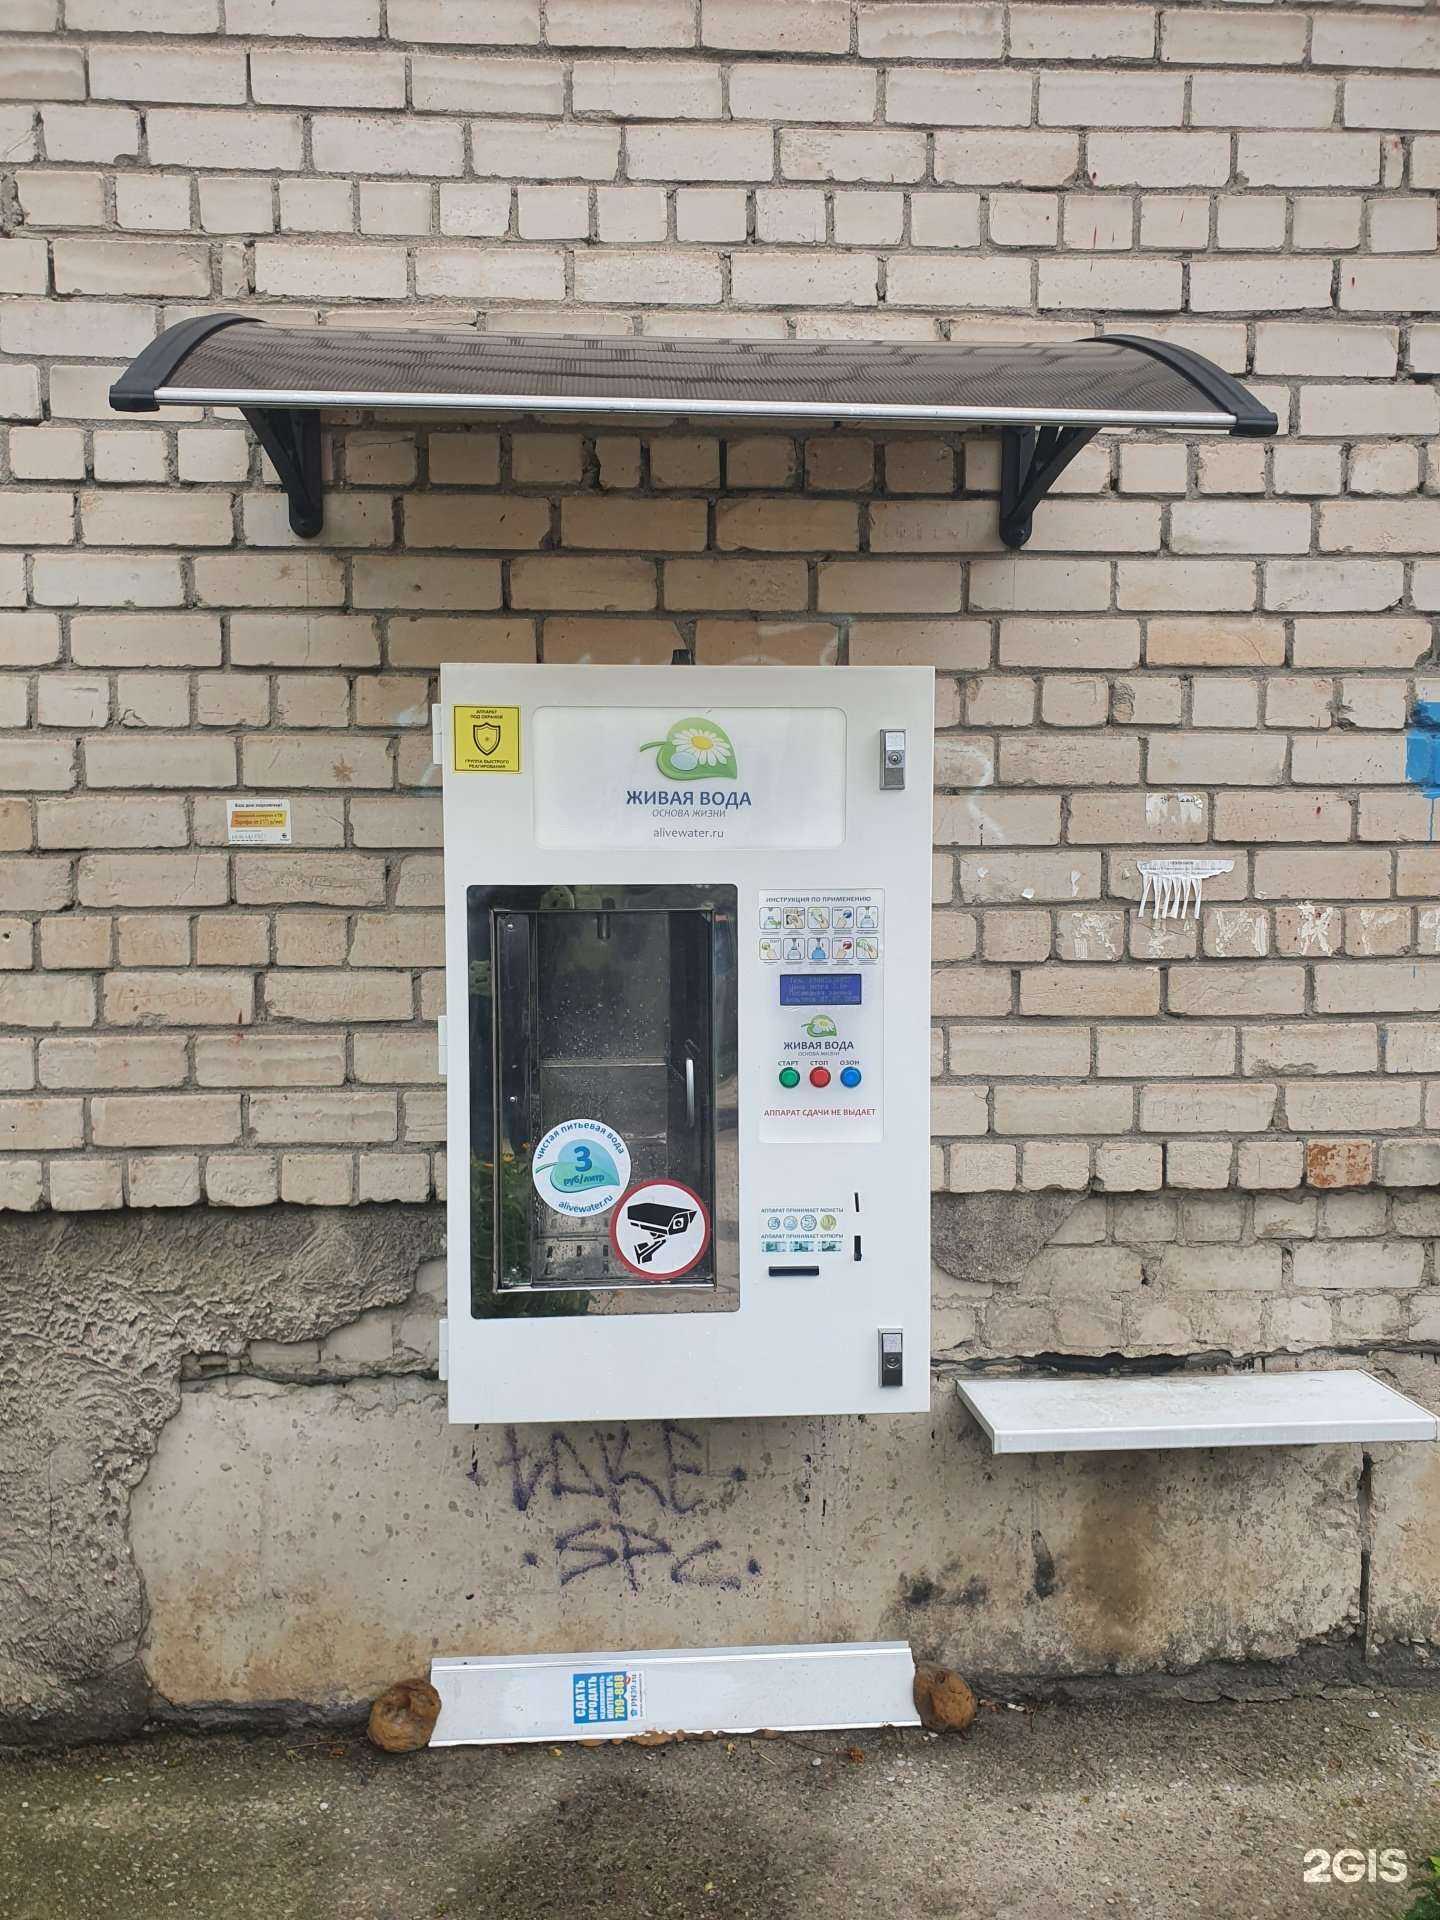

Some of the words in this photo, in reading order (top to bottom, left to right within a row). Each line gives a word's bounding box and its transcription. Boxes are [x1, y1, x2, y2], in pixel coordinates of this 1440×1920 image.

[626, 790, 694, 805] ЖИВАЯ
[700, 791, 752, 810] ВОДА
[652, 809, 690, 818] ОСНОВА
[692, 809, 726, 818] ЖИЗНИ
[653, 828, 724, 838] alivewater.ru
[783, 1041, 822, 1050] ЖИВАЯ
[824, 1041, 854, 1051] ВОДА
[764, 1109, 800, 1117] АППАРАТ
[802, 1109, 829, 1118] СДАЧИ
[843, 1108, 877, 1117] ВЫДАЕТ
[537, 1129, 560, 1160] чистая
[560, 1122, 606, 1136] питьевая
[606, 1132, 625, 1155] вода
[574, 1145, 593, 1172] 3
[563, 1174, 605, 1187] руб/литр
[558, 1194, 613, 1214] alivewater.ru
[575, 1680, 586, 1718] СДАТЬ
[588, 1676, 598, 1720] ПРОДАТЬ
